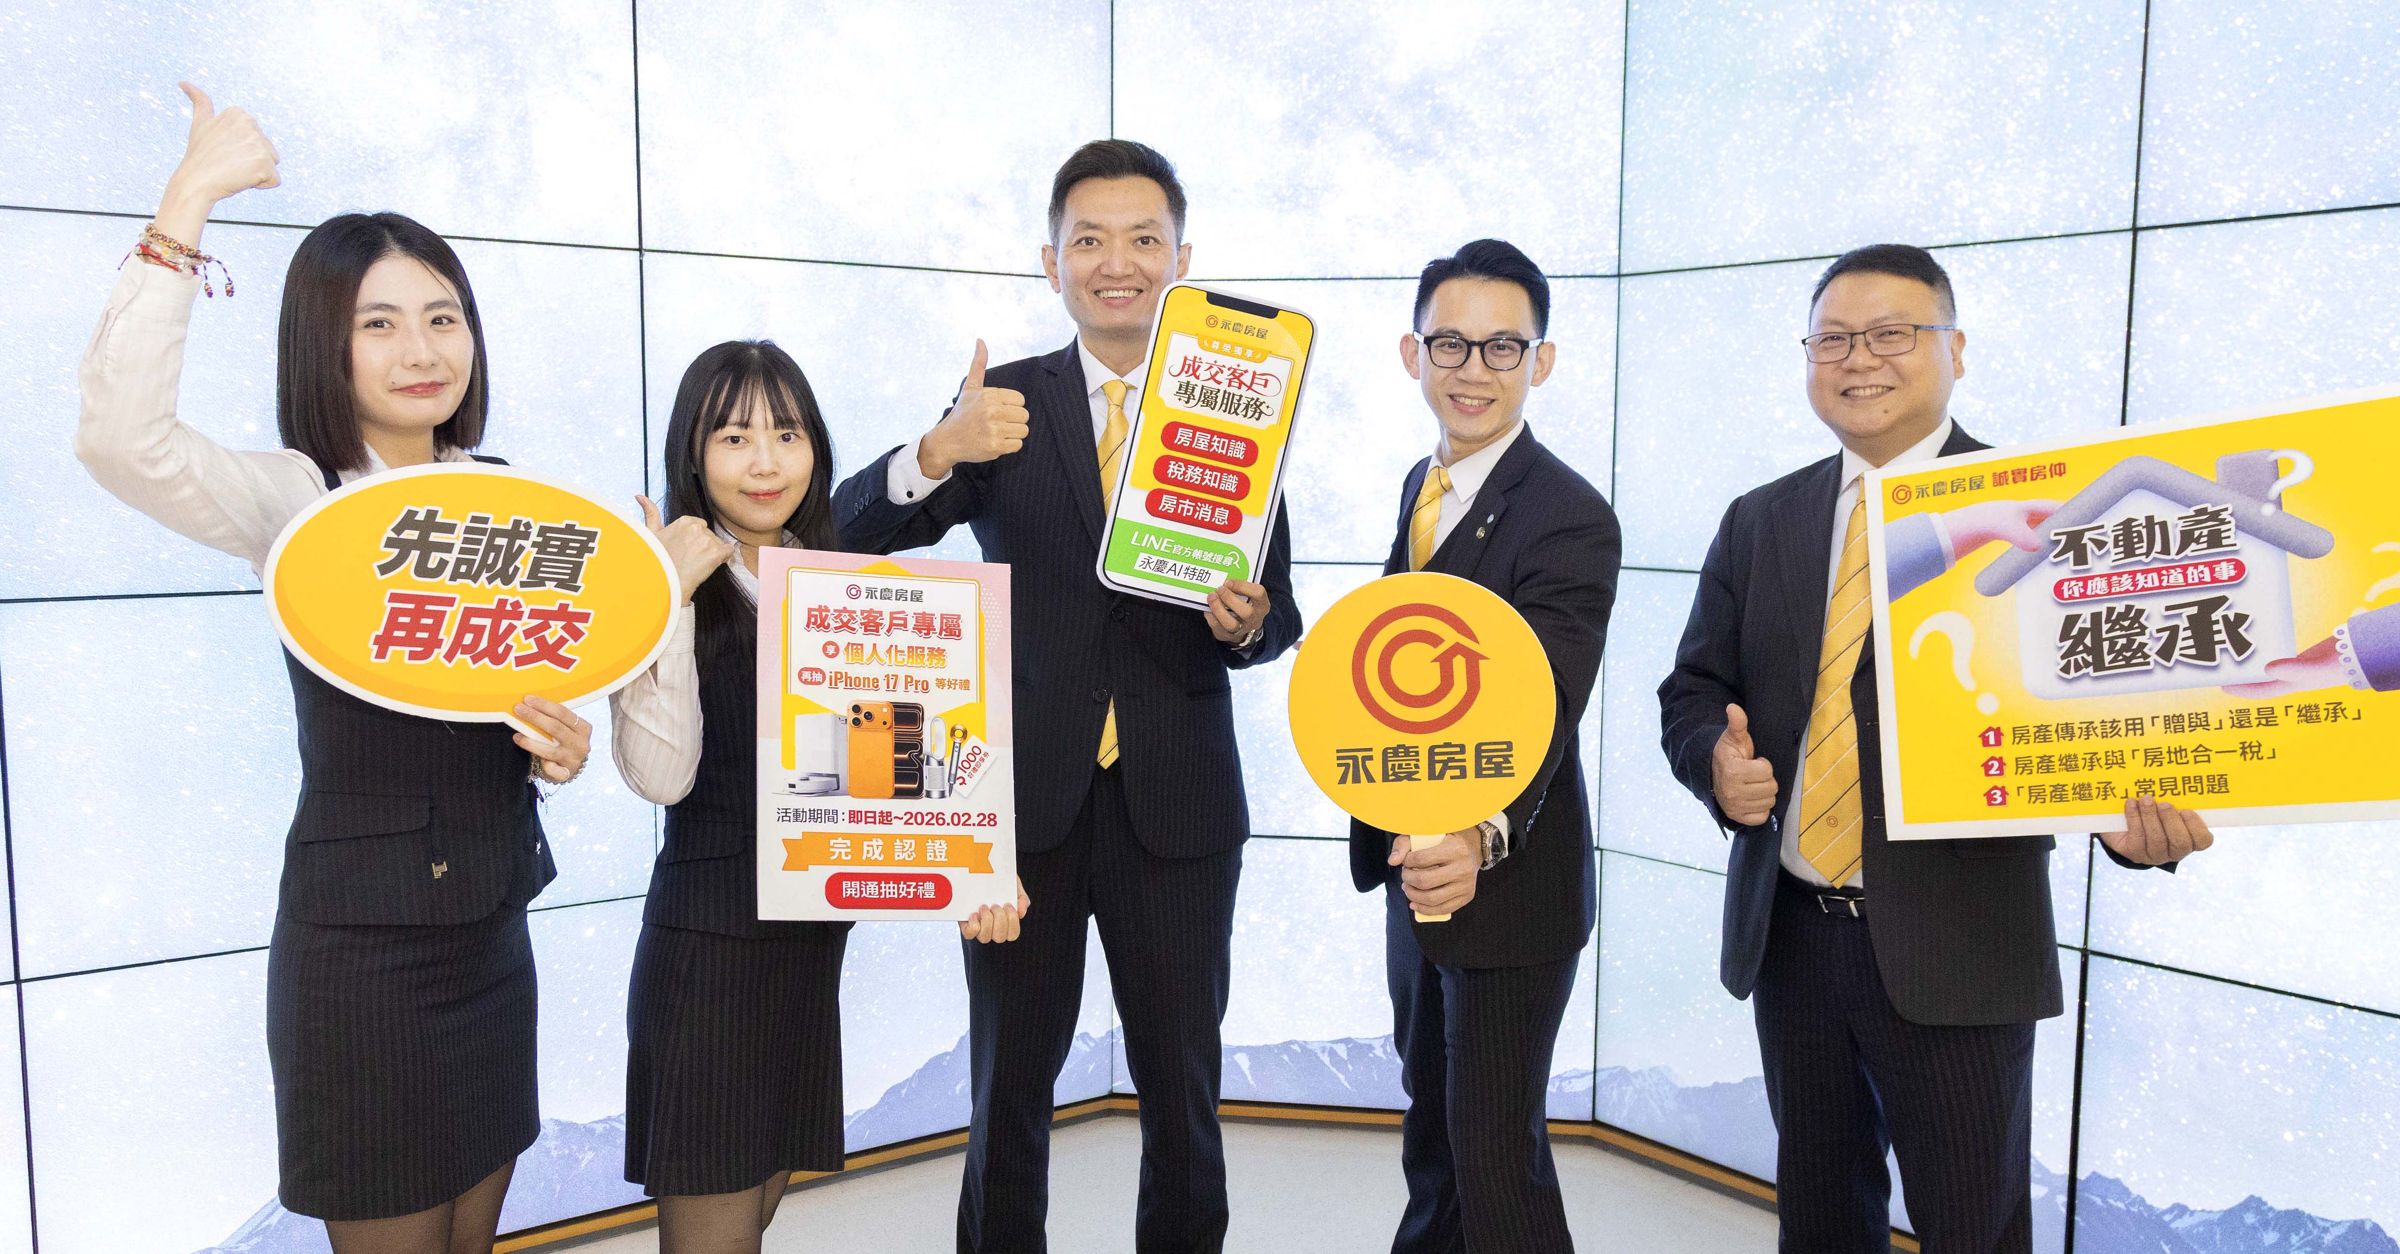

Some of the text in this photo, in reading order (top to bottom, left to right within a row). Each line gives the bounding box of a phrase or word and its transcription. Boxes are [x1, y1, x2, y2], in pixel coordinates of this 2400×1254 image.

[1220, 319, 1268, 340] 永慶房屋
[1169, 355, 1281, 397] 成交客戶
[1174, 380, 1274, 421] 專屬服務
[1174, 427, 1247, 460] 房屋知識
[1166, 461, 1239, 493] 稅務知識
[1915, 462, 2066, 499] 永慶房屋 誠實房仲
[1158, 494, 1229, 526] 房市消息
[376, 508, 597, 592] 先誠實
[2052, 506, 2238, 568] 不動產
[1138, 556, 1211, 583] 永慶AI特助
[2060, 560, 2239, 599] 你應該知道的事
[865, 586, 923, 603] 永慶房屋
[372, 592, 591, 670] 再成交
[805, 605, 962, 639] 成交客戶專屬
[2056, 595, 2254, 678] 繼承
[825, 642, 947, 668] 享 個人化服務
[800, 671, 970, 693] 再抽 iPhone 17 Pro 等好禮
[1984, 730, 1997, 746] 1
[1336, 741, 1515, 785] 永慶房屋
[1987, 759, 2000, 775] 2
[1989, 788, 2003, 805] 3
[829, 837, 949, 862] 完成認證
[842, 880, 936, 899] 開通抽好禮
